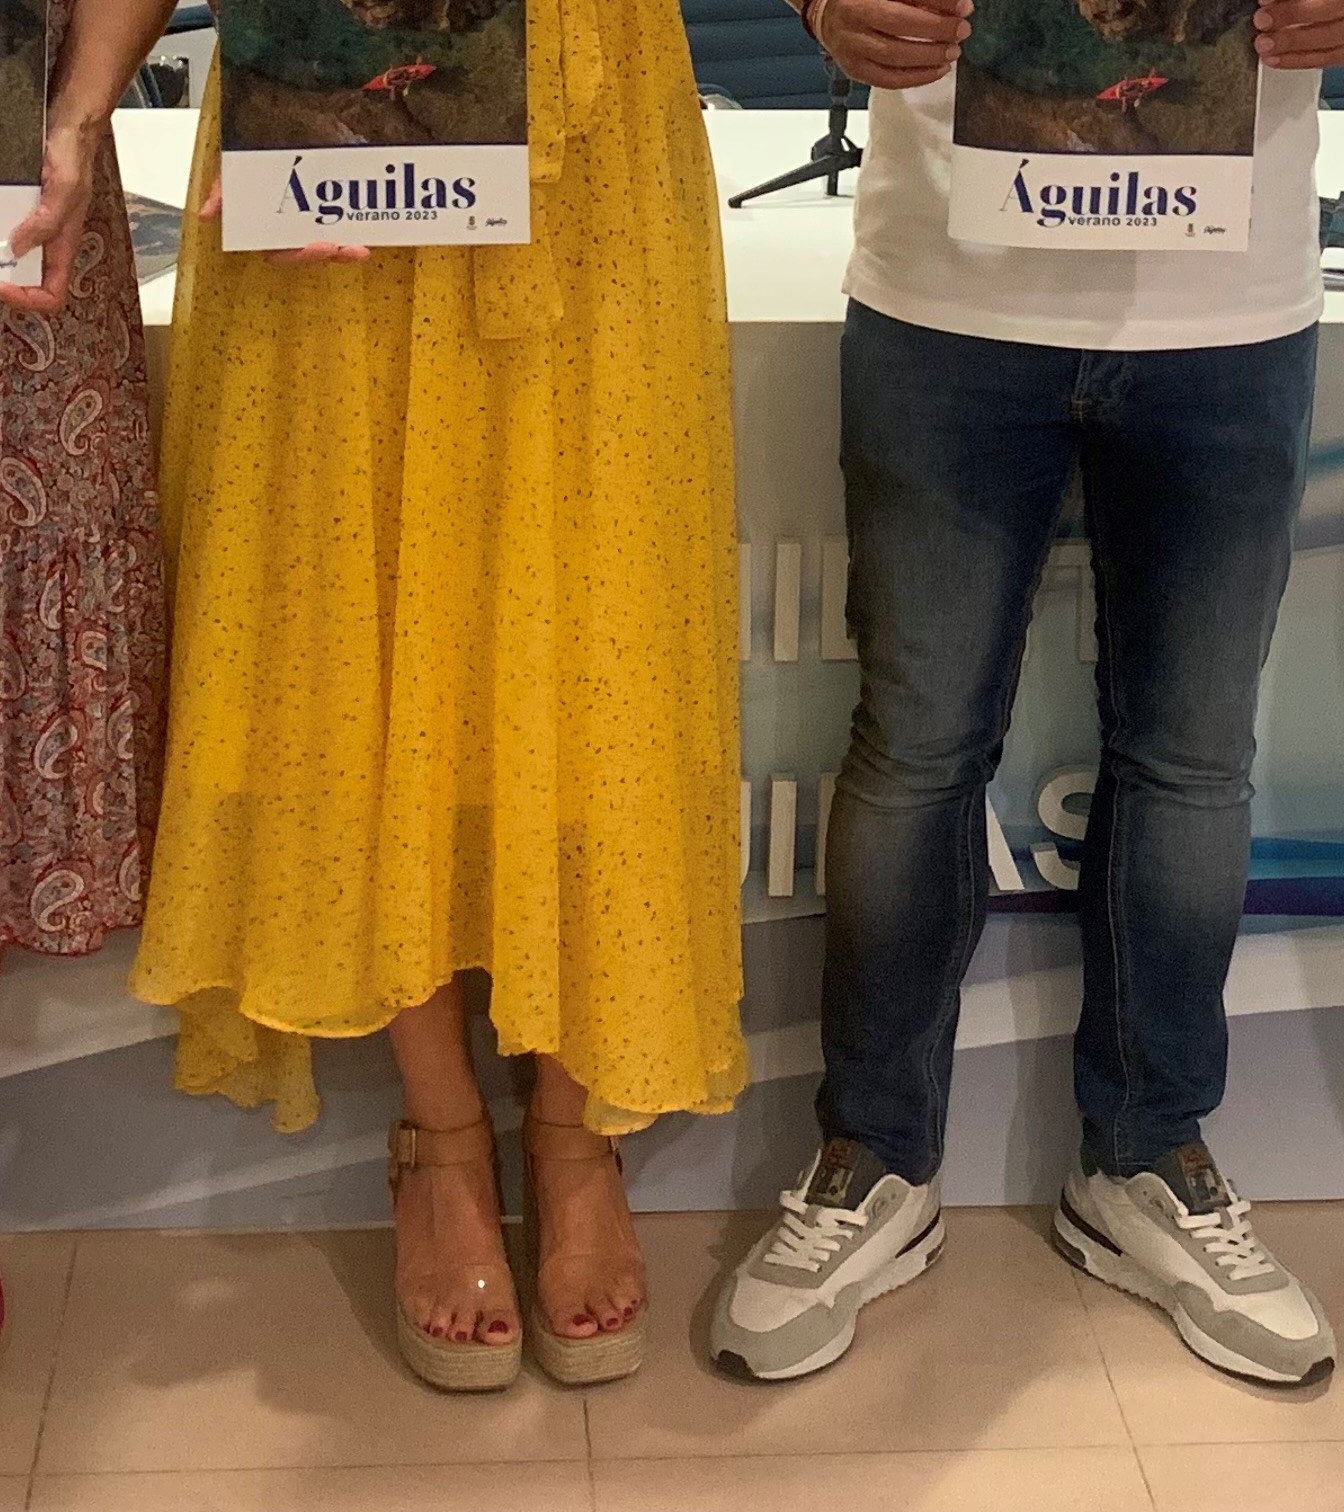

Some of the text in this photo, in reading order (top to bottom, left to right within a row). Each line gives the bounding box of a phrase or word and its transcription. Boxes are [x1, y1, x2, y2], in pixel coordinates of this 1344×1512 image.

[275, 154, 477, 226] Águilas
[999, 157, 1197, 229] Águilas
[347, 210, 438, 222] verano 2023
[1068, 216, 1158, 227] verano 2023
